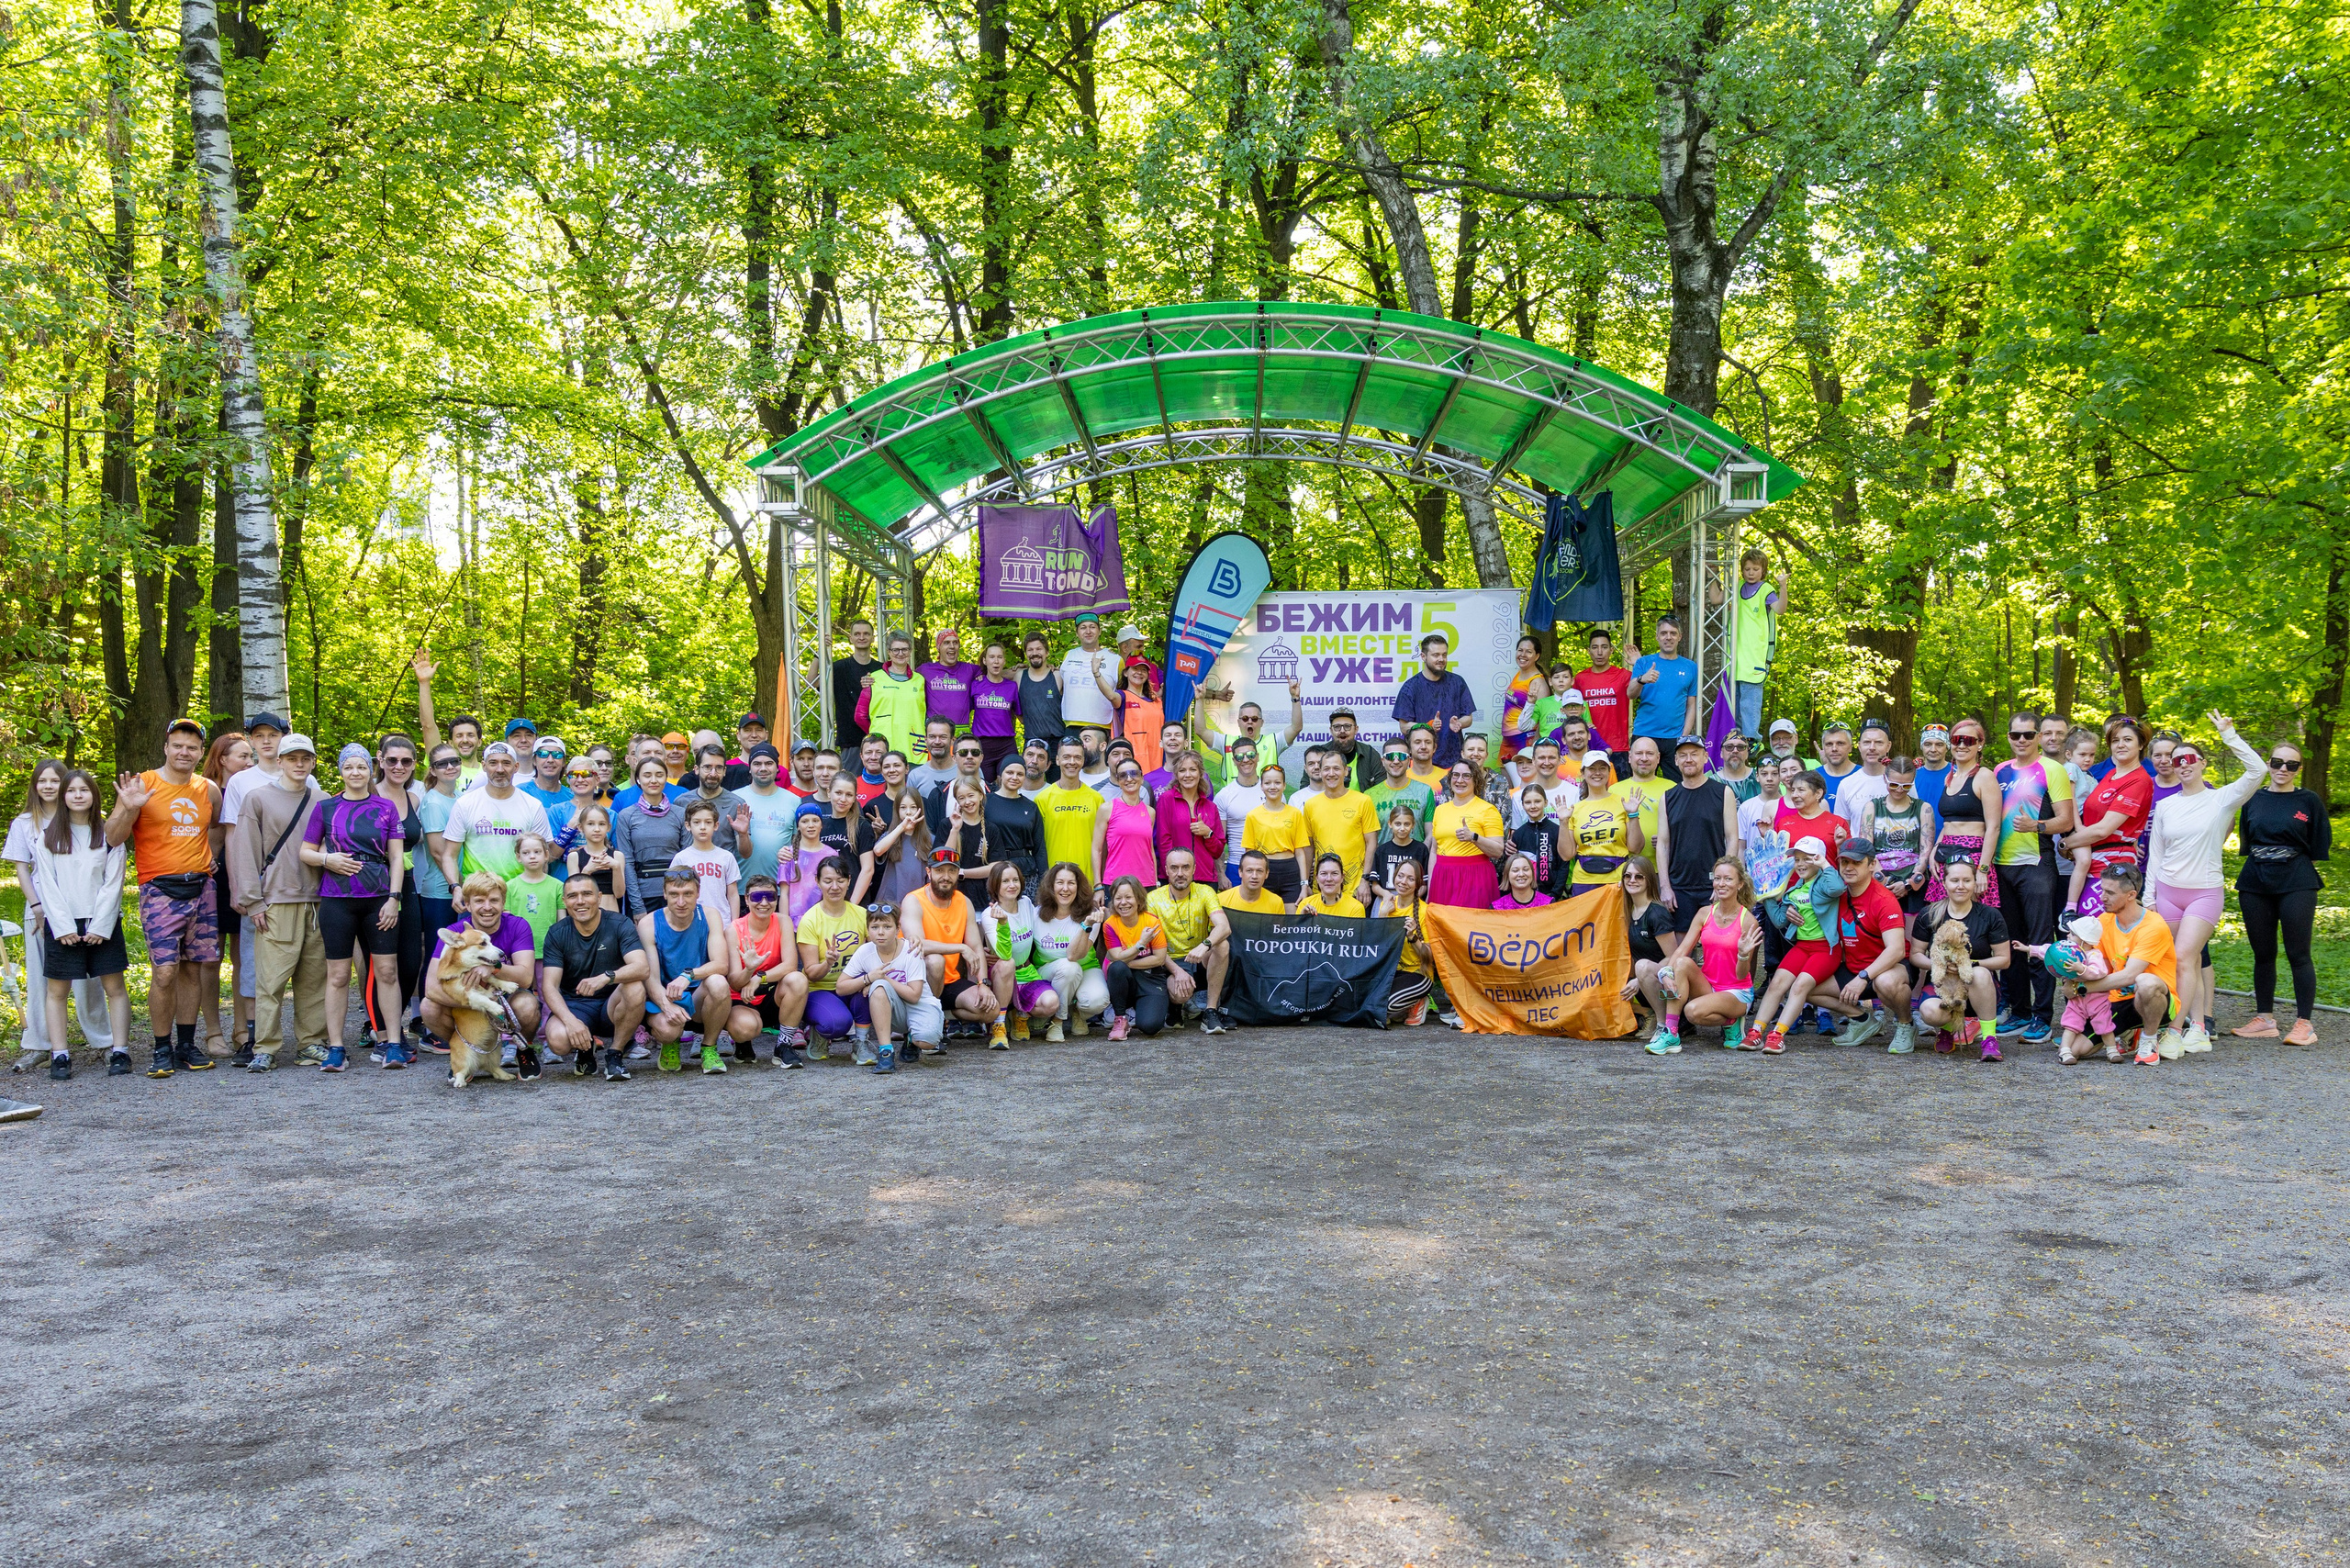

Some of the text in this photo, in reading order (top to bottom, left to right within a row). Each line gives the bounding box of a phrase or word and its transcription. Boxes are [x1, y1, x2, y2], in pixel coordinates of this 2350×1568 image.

[1046, 551, 1084, 571] RUN
[1257, 602, 1460, 656] БЕЖИМ 5
[1493, 601, 1512, 665] 2026
[1300, 634, 1412, 655] ВМЕСТЕ
[1309, 657, 1460, 683] УЖЕ ЛТ
[1069, 677, 1097, 686] БЕ
[1299, 696, 1396, 706] НАШИ ВОЛОНТЕ
[1584, 688, 1616, 697] ГОНКА
[1296, 733, 1334, 742] НАШИ
[1579, 827, 1619, 845] БЕГ
[1388, 855, 1413, 863] DRAM
[1539, 832, 1549, 881] PROGRESS
[692, 861, 722, 879] 1965
[1016, 926, 1028, 935] RUN
[1272, 924, 1355, 940] Беговой клуб
[1245, 938, 1380, 958] ГОРОЧКИ RUN
[1483, 968, 1603, 1002] ЛЁШКИНСКИЙ
[1526, 1006, 1559, 1024] ЛЕС
